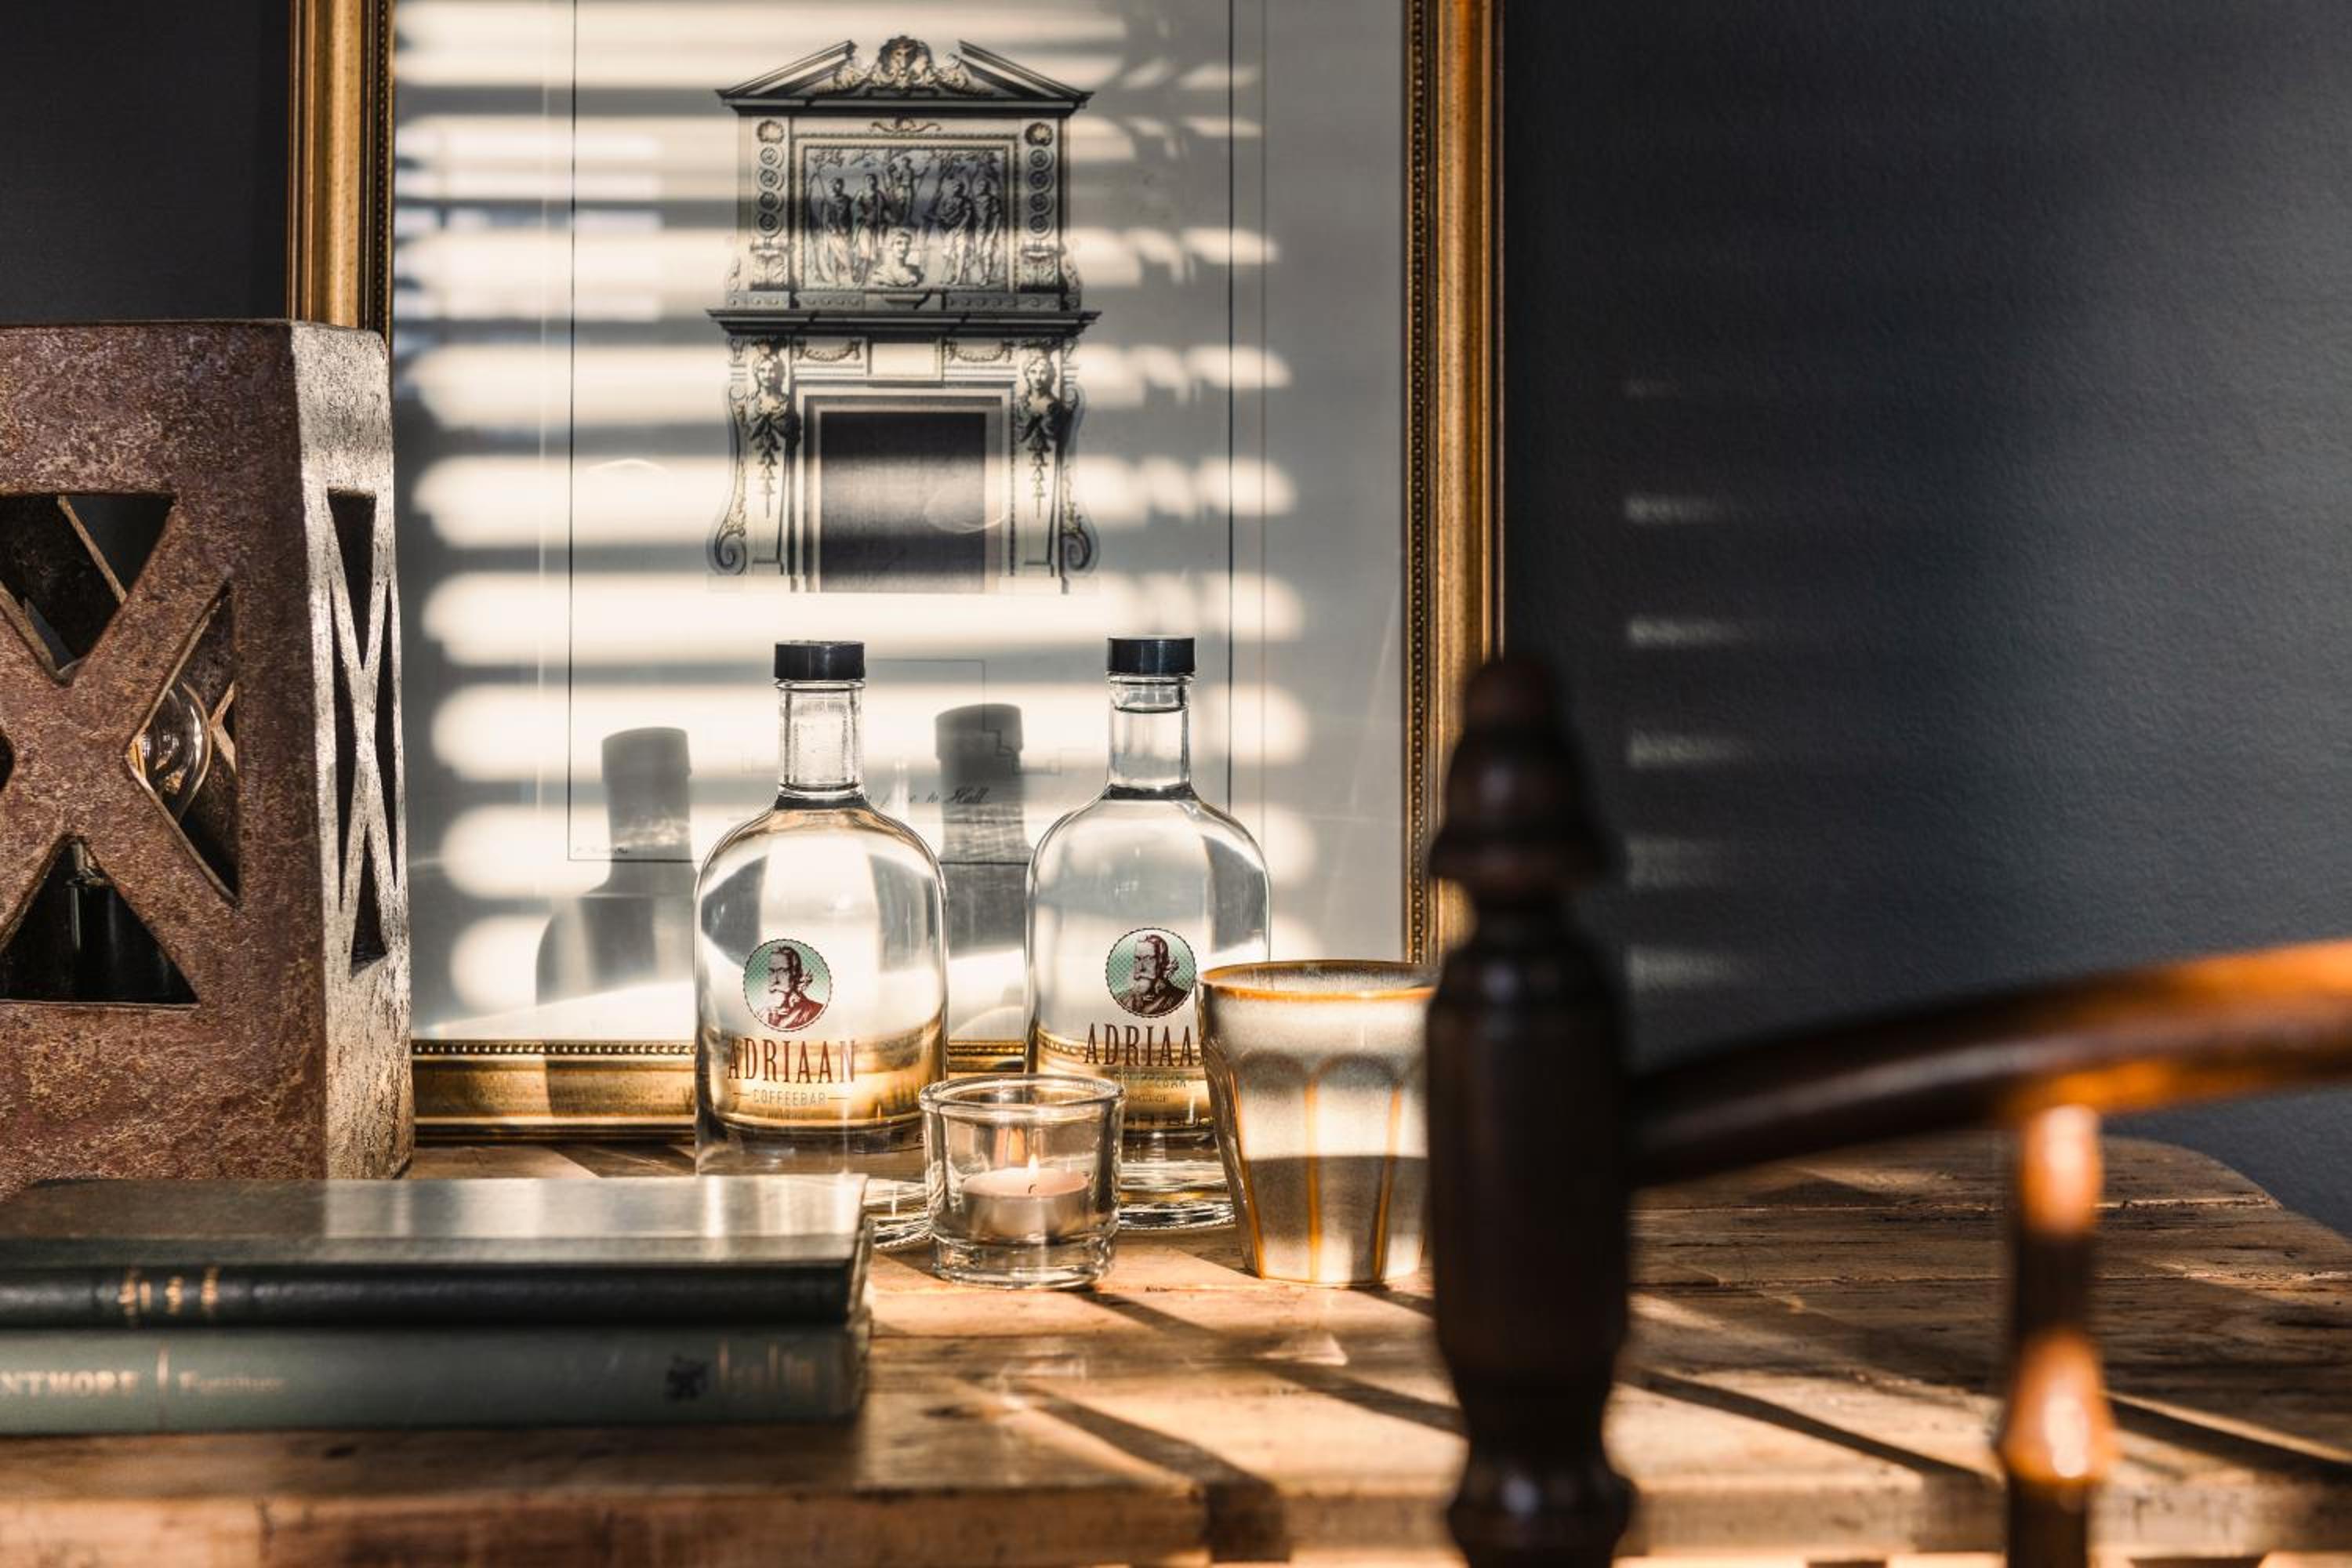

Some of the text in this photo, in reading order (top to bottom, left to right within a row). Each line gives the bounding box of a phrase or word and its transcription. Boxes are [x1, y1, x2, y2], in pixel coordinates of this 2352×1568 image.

[728, 1036, 856, 1083] ADRIAAN
[1083, 1022, 1205, 1067] ADRIAA
[753, 1089, 827, 1106] COFFEEBAR
